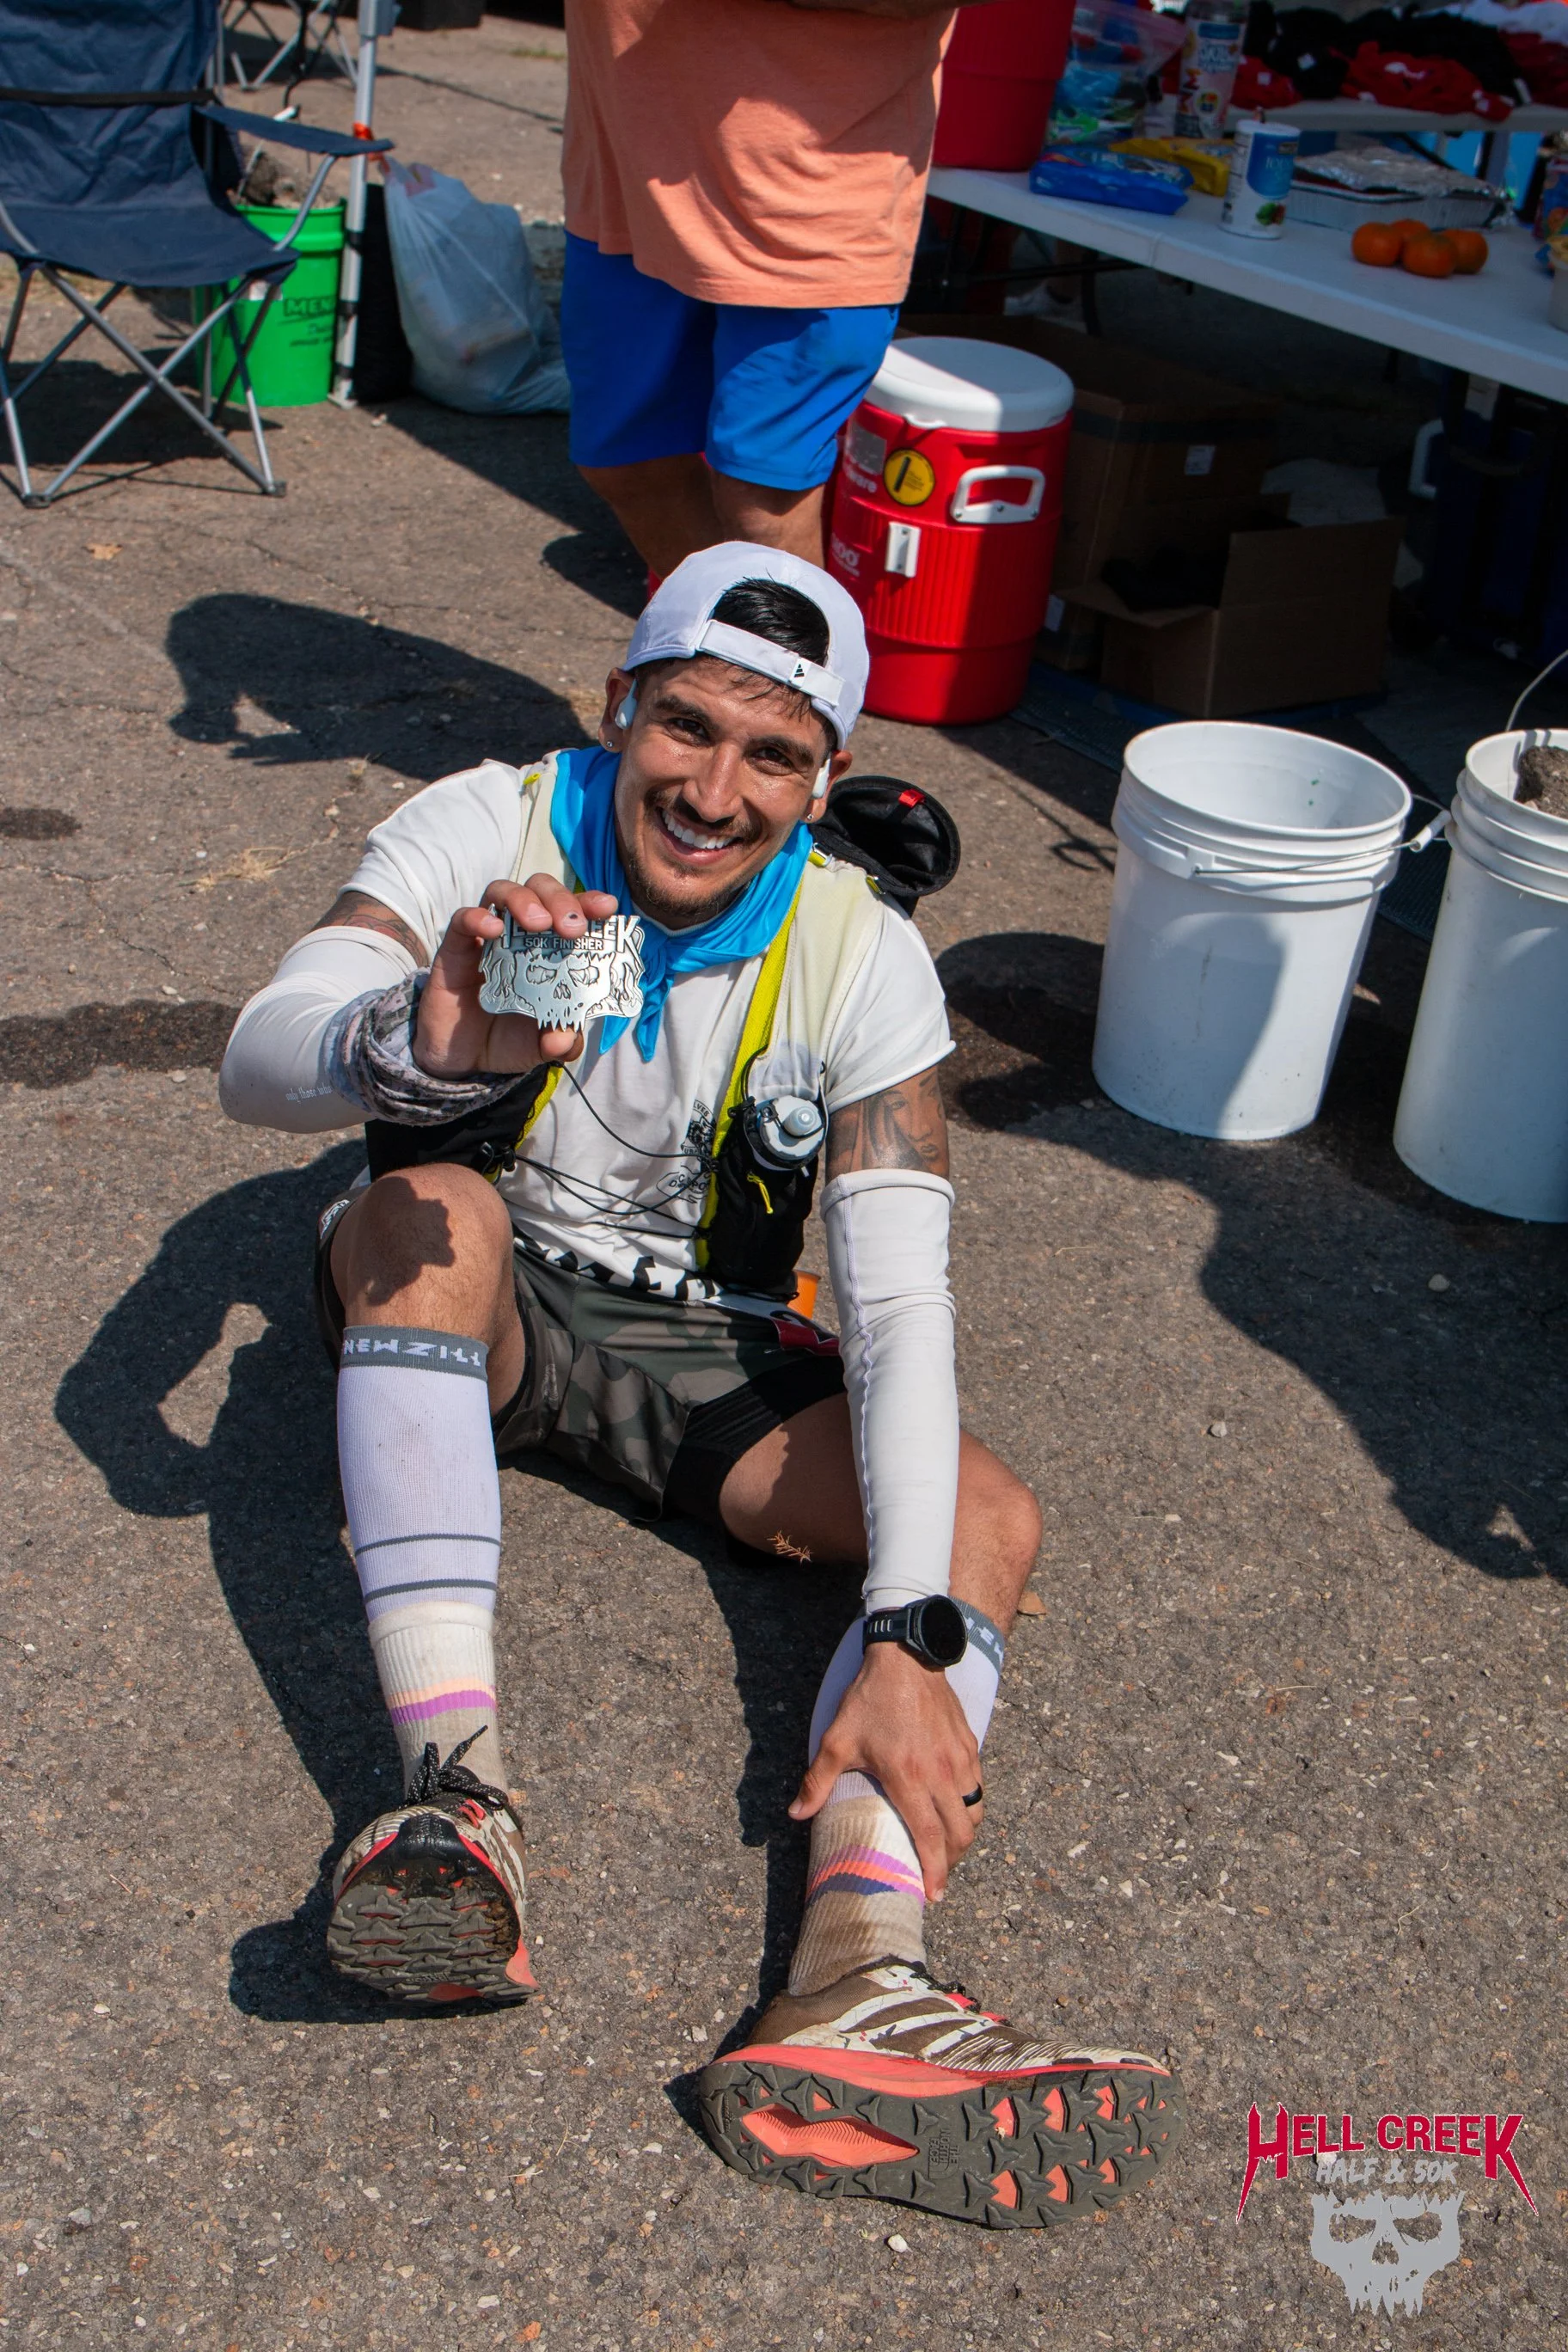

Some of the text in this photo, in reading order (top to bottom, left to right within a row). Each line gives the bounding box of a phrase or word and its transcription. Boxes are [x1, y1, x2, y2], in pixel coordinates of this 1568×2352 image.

[524, 937, 603, 950] 50K FINISHER
[296, 1086, 316, 1099] those
[929, 2137, 940, 2163] FACE
[939, 2128, 950, 2163] NORTH
[950, 2146, 959, 2164] THE
